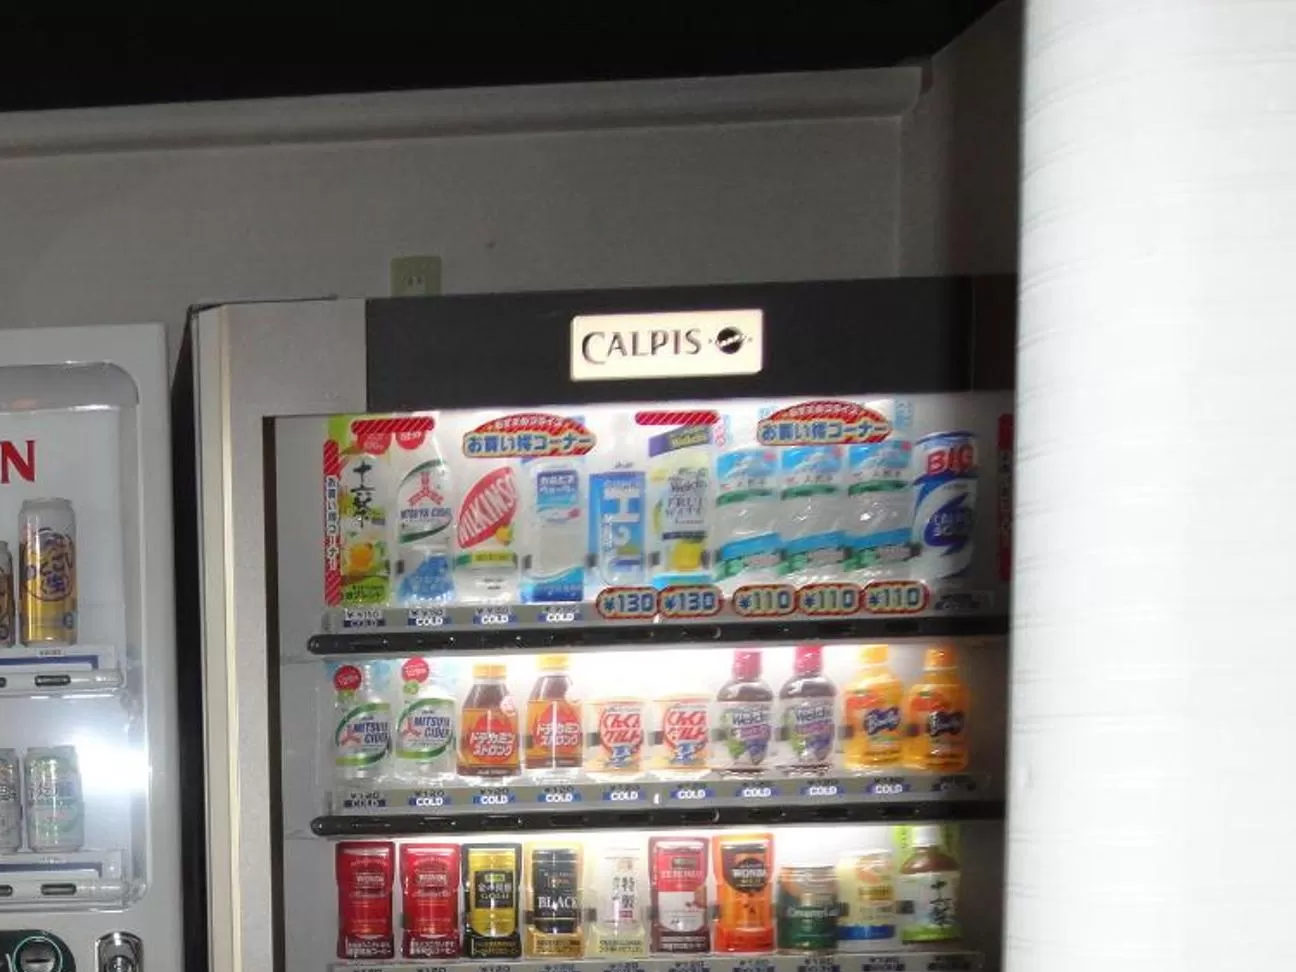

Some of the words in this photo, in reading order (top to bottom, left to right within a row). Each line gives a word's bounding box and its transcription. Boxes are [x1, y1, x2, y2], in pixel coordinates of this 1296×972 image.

[582, 328, 701, 365] CALPIS
[761, 423, 888, 441] お買い得コーナー
[468, 434, 592, 452] お買い得コーナー
[927, 444, 974, 476] BIG
[665, 592, 716, 611] ¥130
[739, 591, 789, 609] ¥110
[805, 590, 854, 608] ¥110
[869, 588, 918, 606] ¥110
[604, 593, 654, 612] ¥130
[415, 618, 443, 626] COLD
[481, 614, 509, 624] COLD
[546, 613, 575, 622] COLD
[743, 788, 772, 798] COLD
[809, 786, 837, 796] COLD
[875, 784, 903, 794] COLD
[481, 795, 509, 804] COLD
[546, 793, 574, 802] COLD
[610, 791, 639, 800] COLD
[678, 790, 706, 799] COLD
[416, 797, 444, 806] COLD
